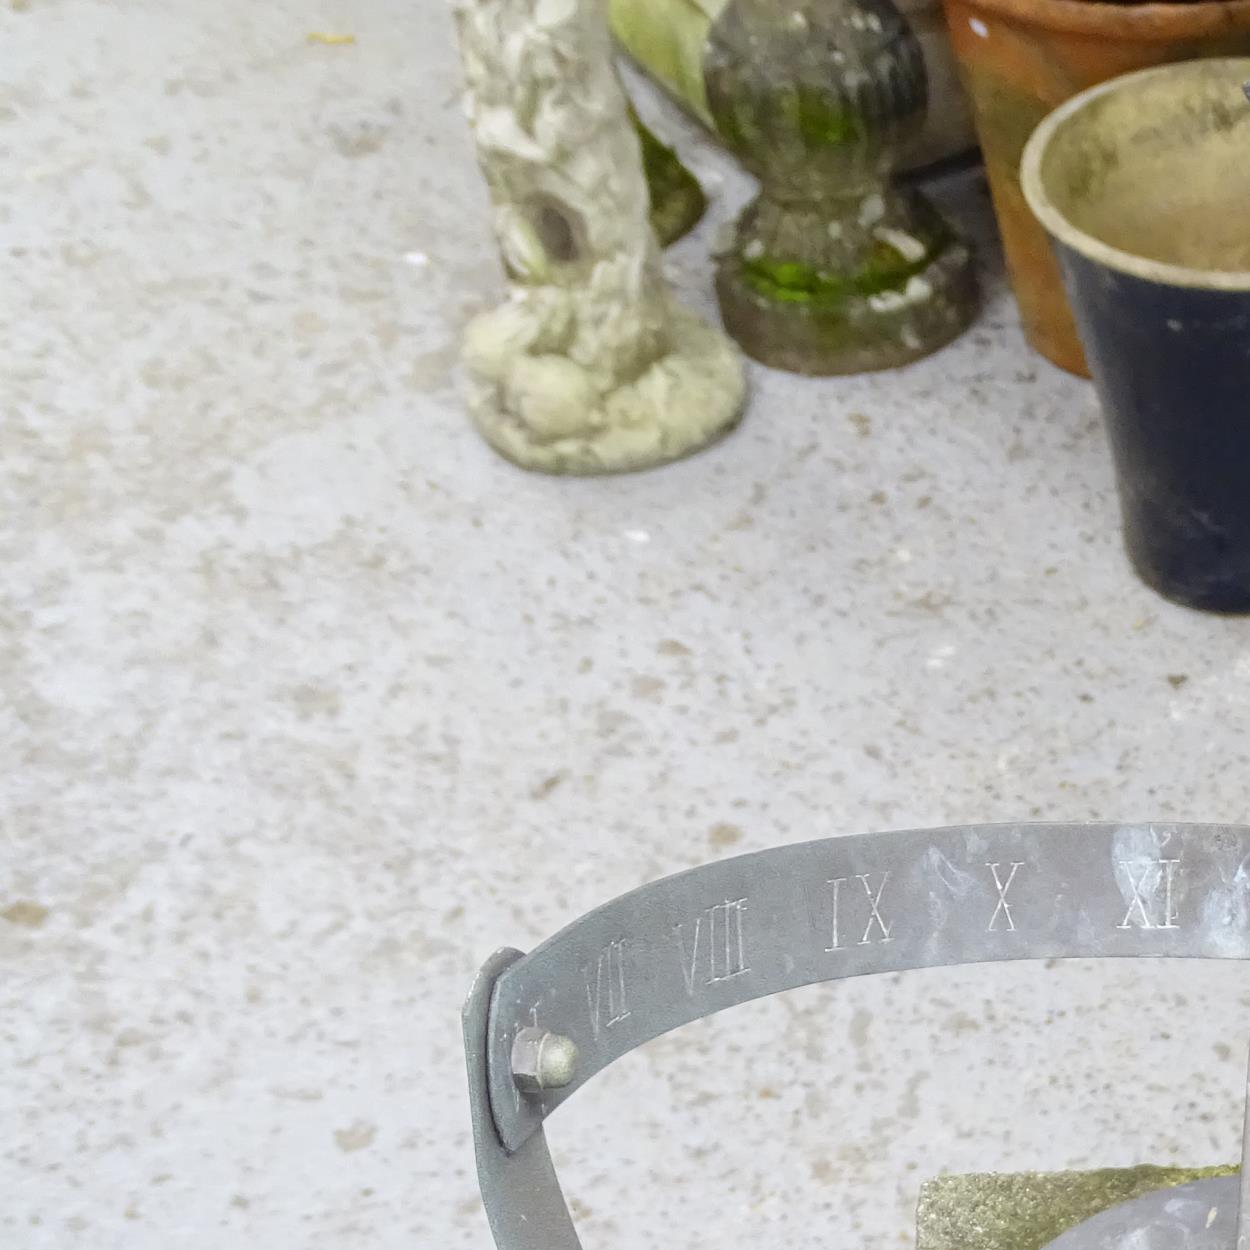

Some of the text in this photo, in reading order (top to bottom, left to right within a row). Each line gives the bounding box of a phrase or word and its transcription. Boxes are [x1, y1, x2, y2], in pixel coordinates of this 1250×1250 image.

[673, 898, 751, 997] VIII
[825, 871, 895, 952] IX
[985, 861, 1026, 932] X
[1116, 859, 1180, 929] XI
